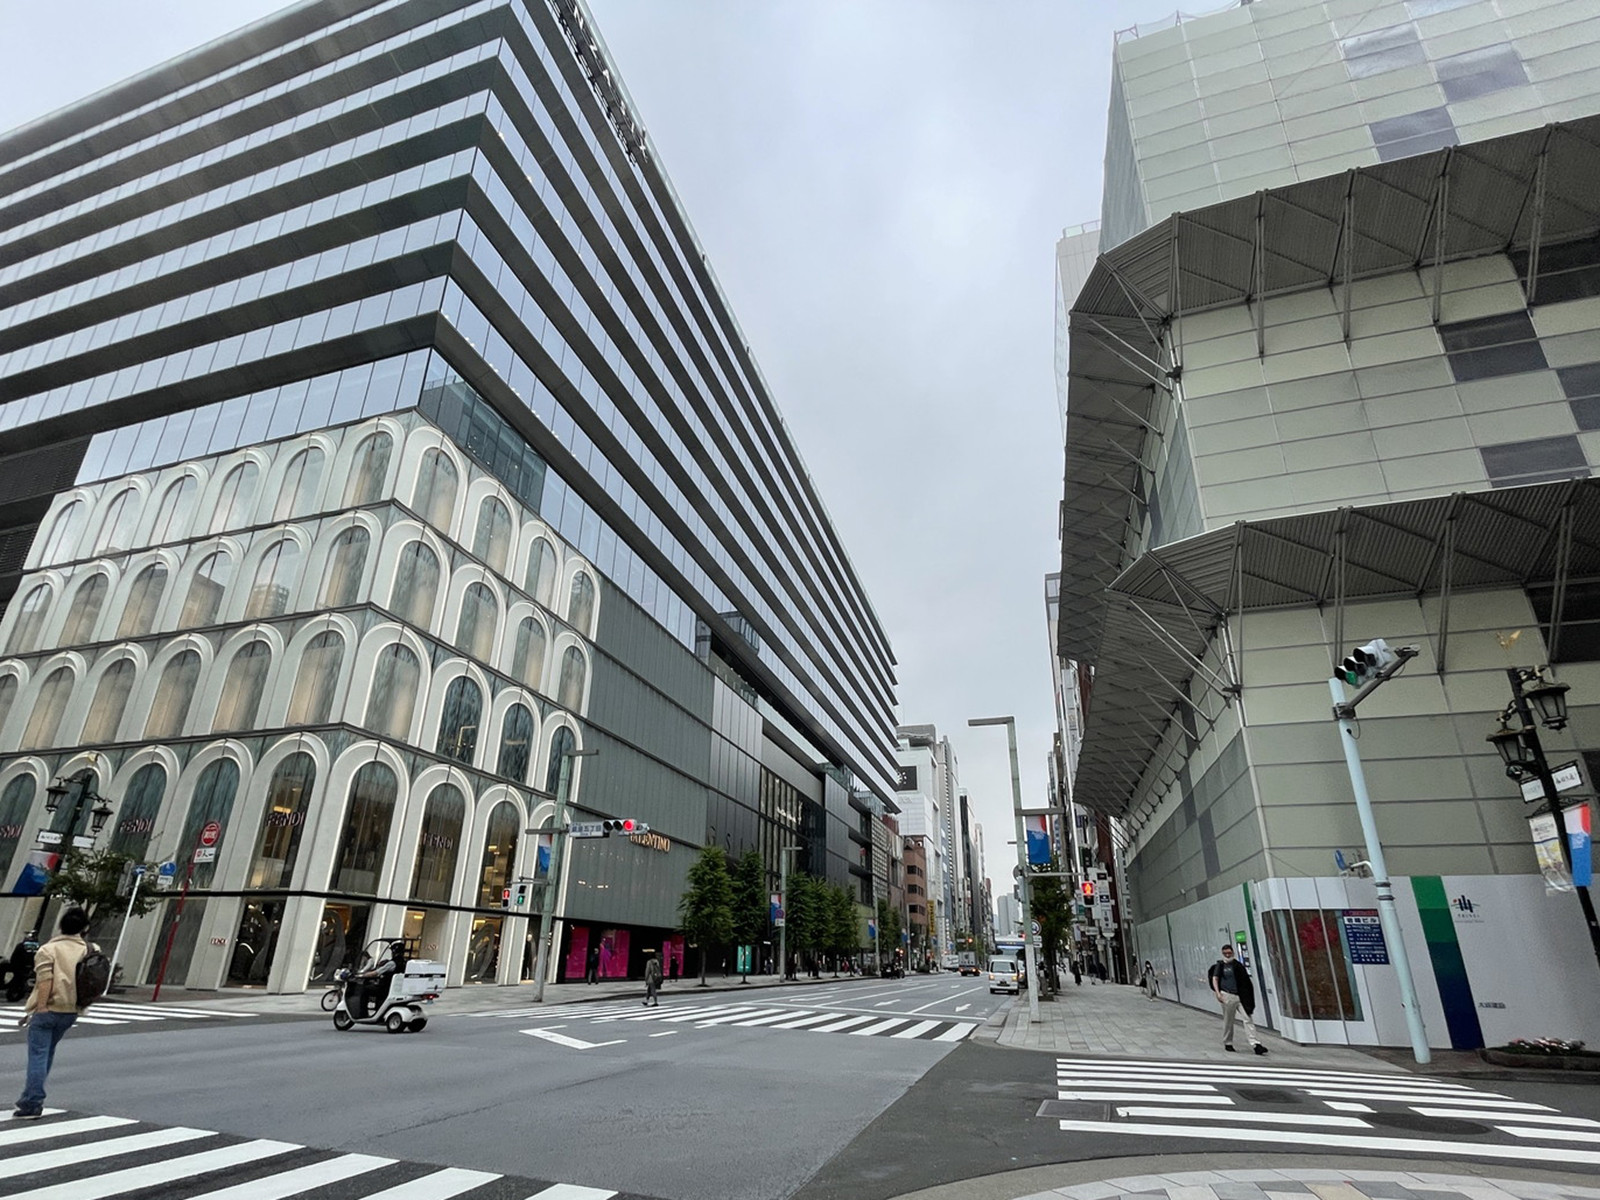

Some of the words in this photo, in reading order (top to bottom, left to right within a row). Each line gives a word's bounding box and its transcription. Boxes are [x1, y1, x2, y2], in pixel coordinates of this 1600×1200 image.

[119, 818, 152, 833] FENDI
[267, 811, 305, 827] FENDI
[423, 832, 453, 849] FENDI
[629, 833, 670, 852] VALENTINO
